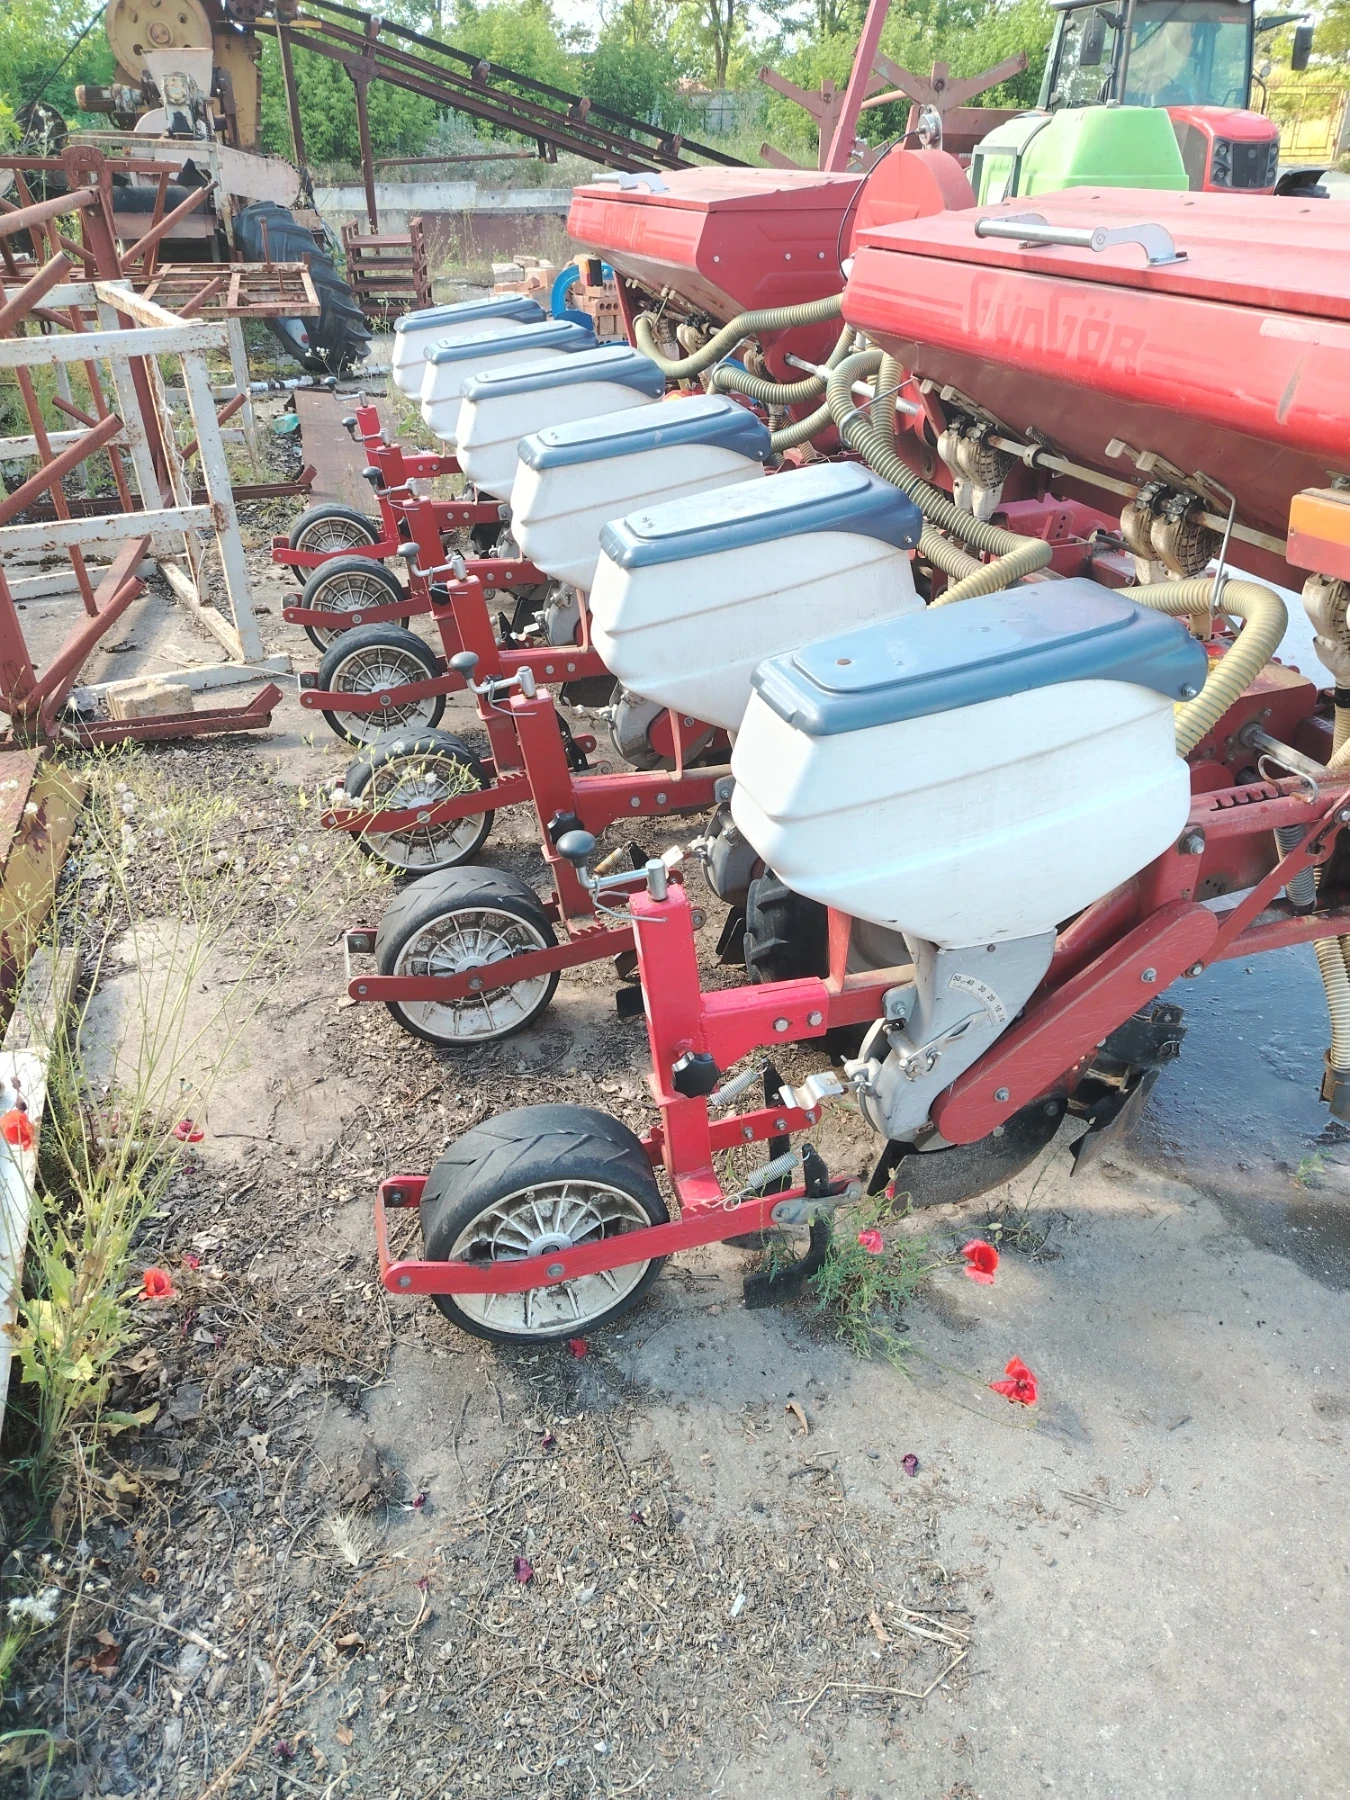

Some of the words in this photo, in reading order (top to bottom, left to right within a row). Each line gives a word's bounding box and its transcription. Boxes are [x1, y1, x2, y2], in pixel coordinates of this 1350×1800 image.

[978, 985, 987, 993] 30
[987, 994, 996, 1002] 20
[995, 1005, 1002, 1013] 10
